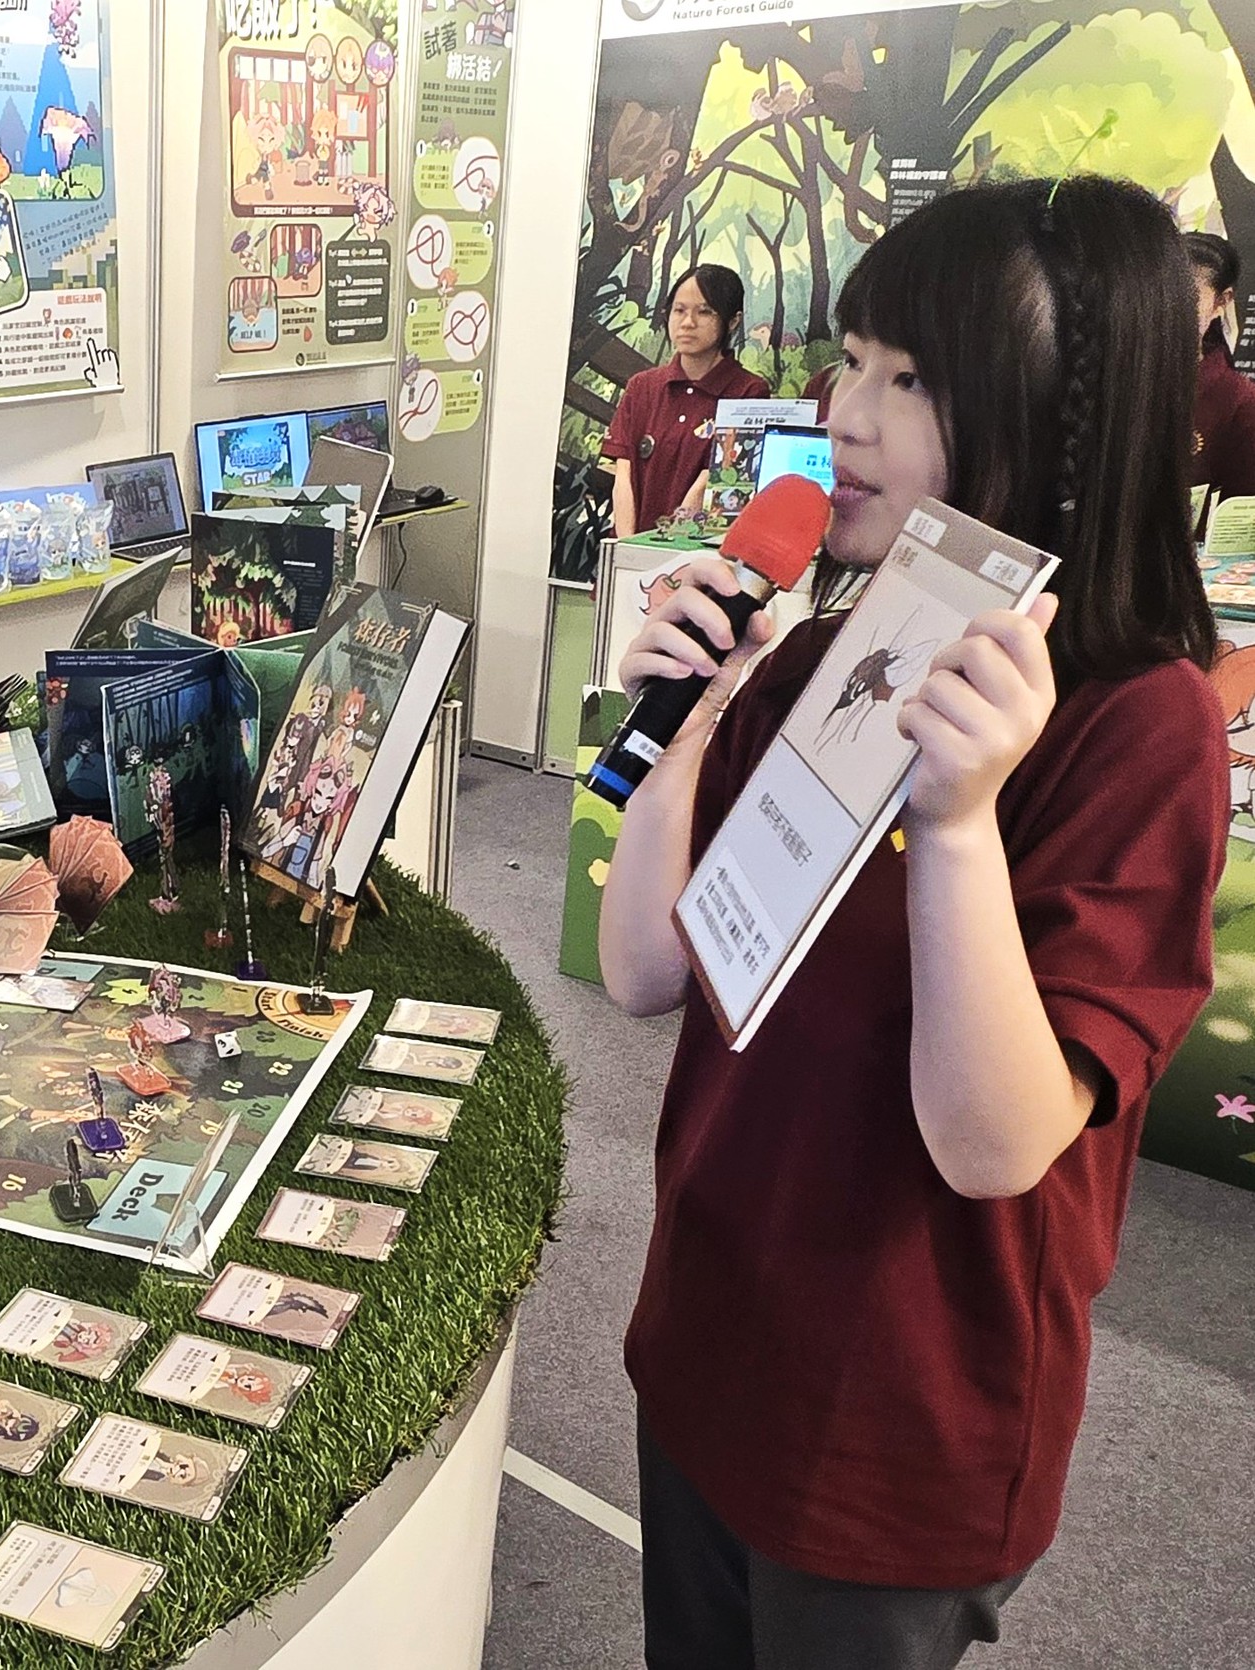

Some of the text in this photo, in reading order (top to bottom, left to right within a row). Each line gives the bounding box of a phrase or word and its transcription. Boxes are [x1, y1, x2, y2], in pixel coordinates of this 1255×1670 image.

[672, 0, 794, 20] Nature Forest Guide
[423, 21, 457, 60] 試著
[262, 991, 276, 1011] Start
[256, 1030, 276, 1043] 23
[277, 1020, 324, 1038] Finish
[268, 1061, 293, 1075] 22
[246, 1102, 271, 1118] 20
[200, 1119, 222, 1135] 19
[2, 1173, 27, 1191] 16
[110, 1172, 164, 1223] Deck
